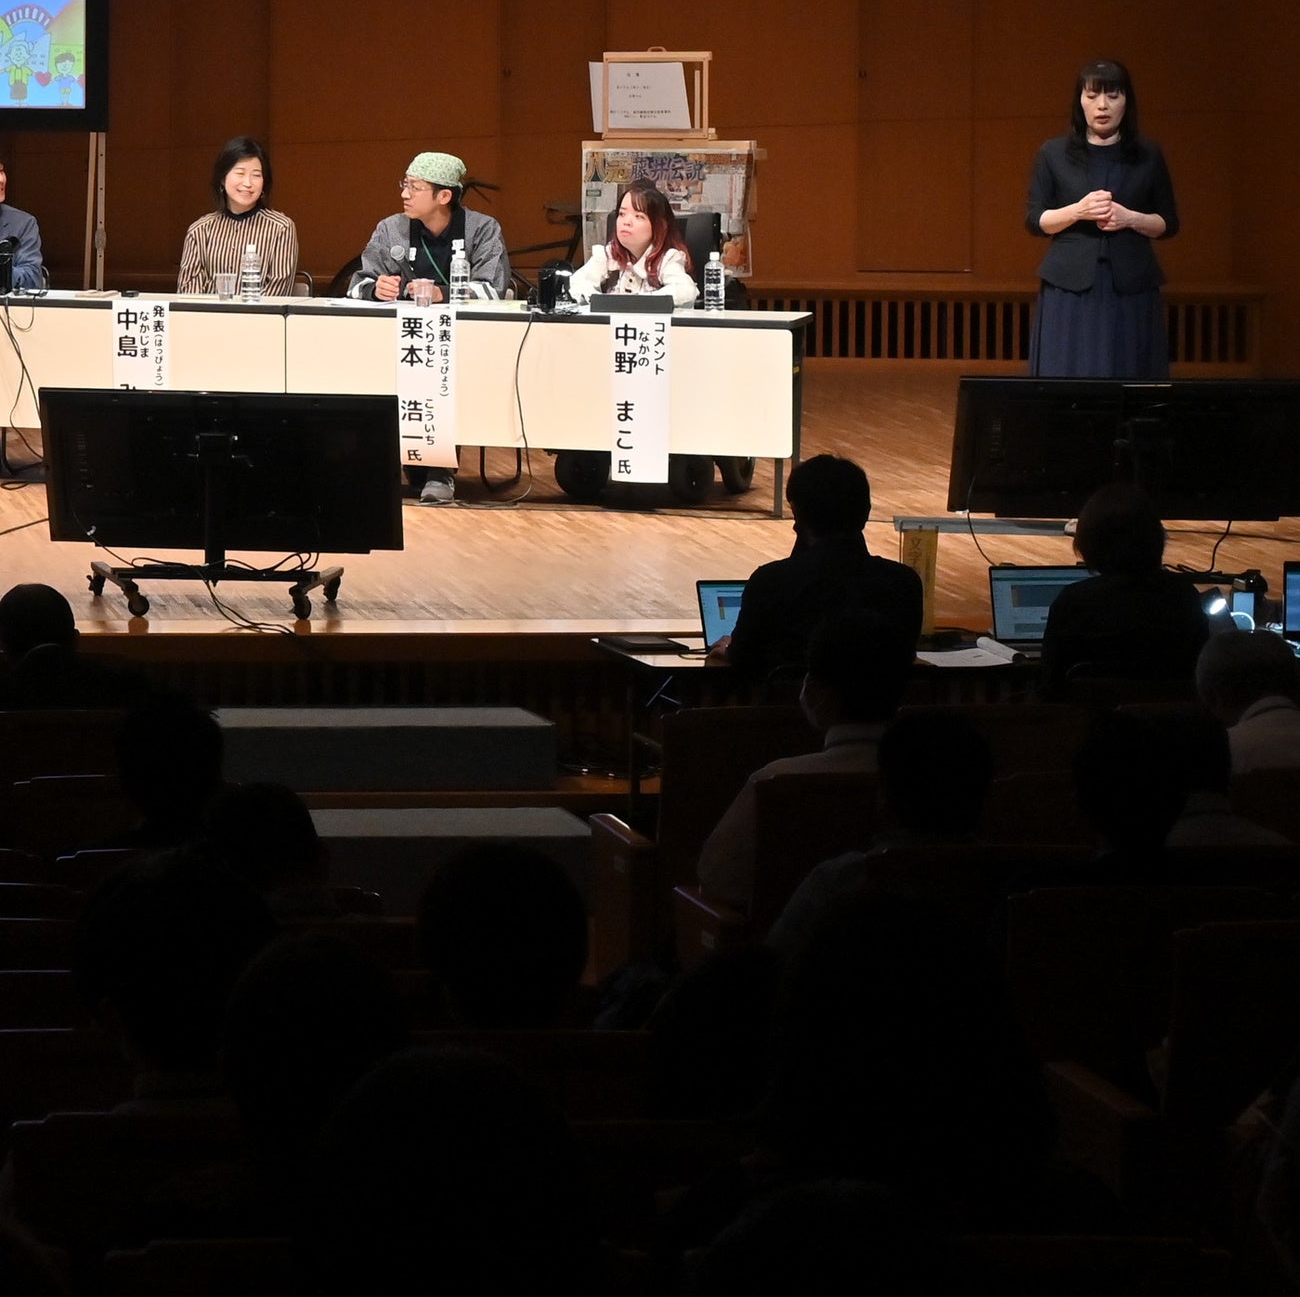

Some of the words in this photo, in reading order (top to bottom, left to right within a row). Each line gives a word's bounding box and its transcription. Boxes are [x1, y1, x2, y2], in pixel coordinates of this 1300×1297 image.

[117, 309, 139, 357] 中島
[139, 312, 150, 358] なかじま
[400, 317, 424, 367] 栗本
[424, 321, 436, 367] くりもと
[614, 323, 638, 374] 中野
[637, 332, 650, 366] なかの
[653, 323, 666, 375] コメント
[424, 399, 436, 445] こういち
